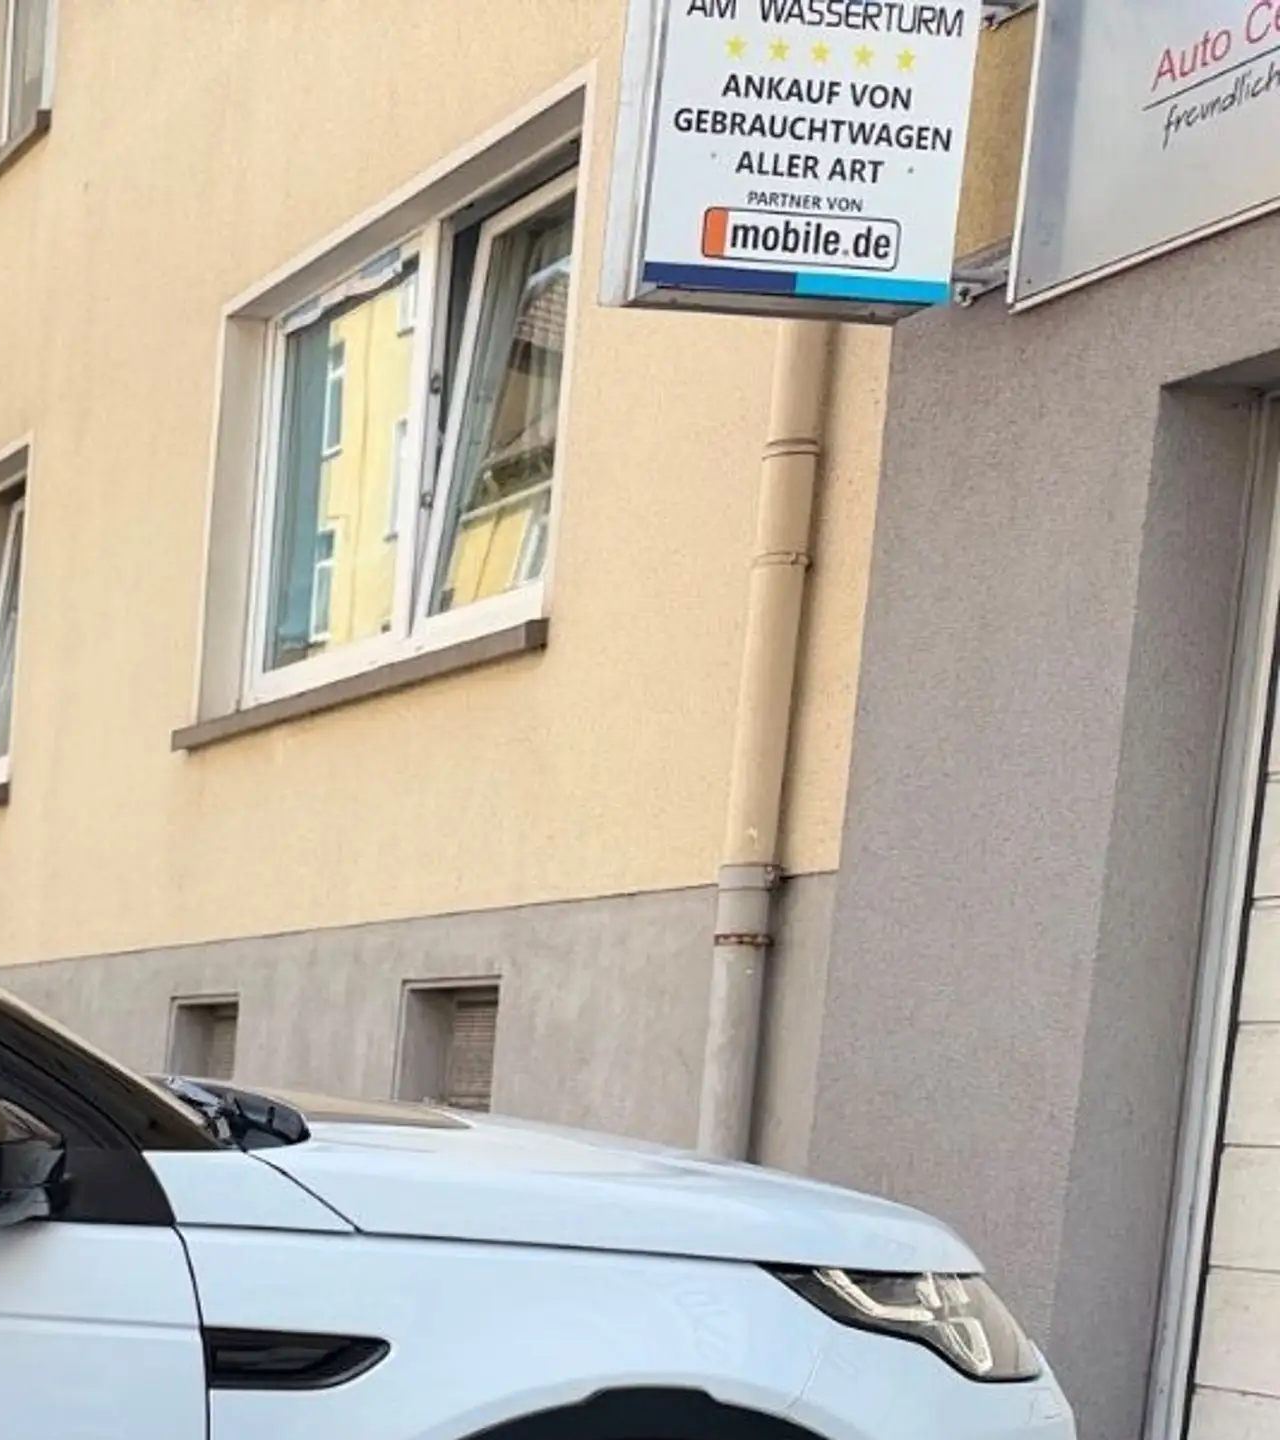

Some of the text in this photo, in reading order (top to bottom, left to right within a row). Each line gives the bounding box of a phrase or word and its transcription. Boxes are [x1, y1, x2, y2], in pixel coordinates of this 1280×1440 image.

[687, 0, 965, 37] AM WASSERTURM
[1151, 29, 1232, 93] Auto
[721, 73, 913, 110] ANKAUF VON
[674, 107, 953, 152] GEBRAUCHTWAGEN
[735, 150, 885, 184] ALLER ART
[747, 190, 864, 212] PARTNER VON
[730, 220, 891, 259] mobile.de
